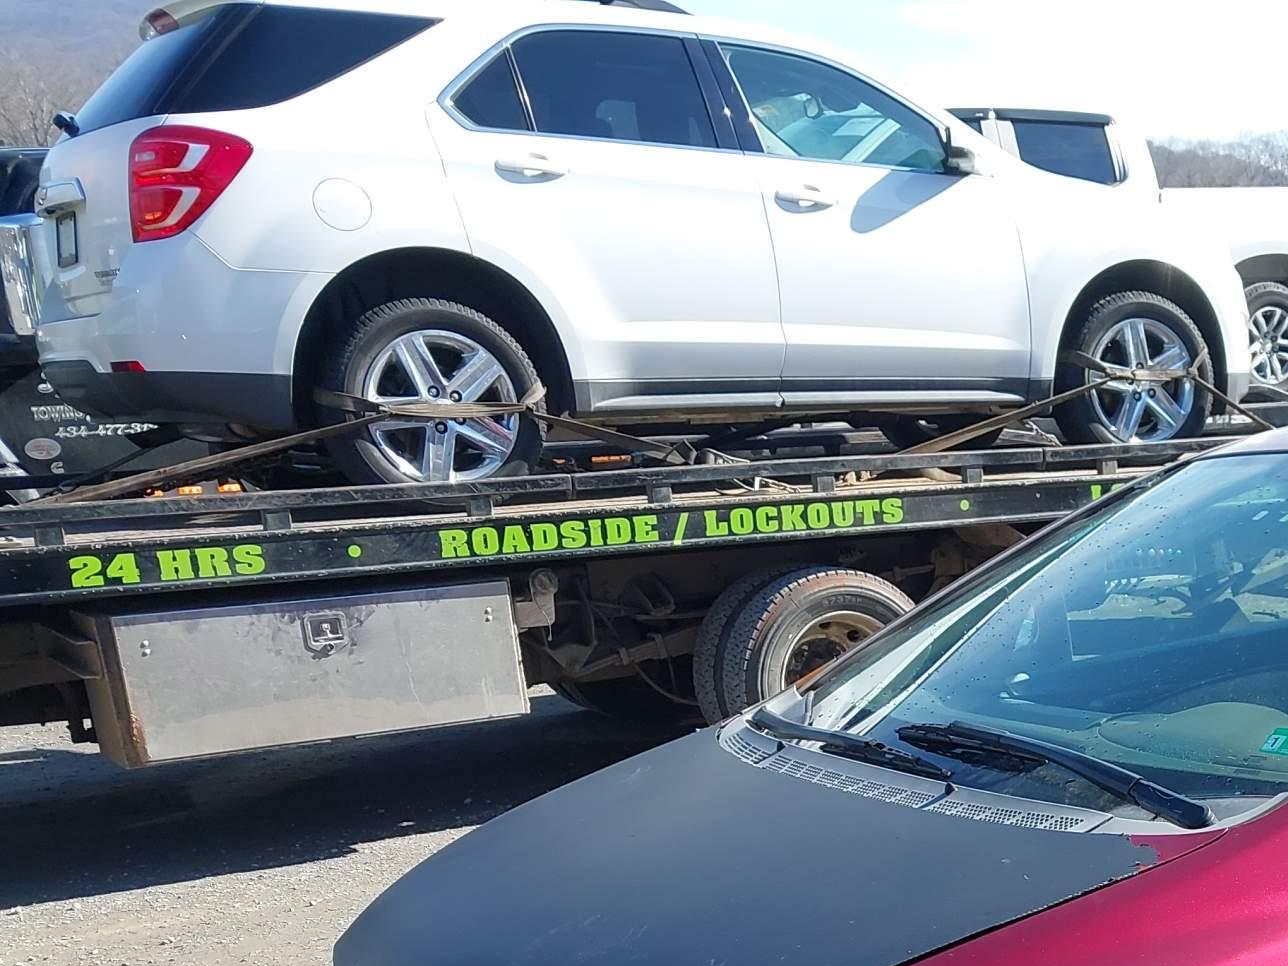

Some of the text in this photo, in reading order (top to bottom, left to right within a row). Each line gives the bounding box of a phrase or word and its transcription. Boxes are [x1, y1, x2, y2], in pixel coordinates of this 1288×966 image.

[69, 553, 141, 588] 24
[156, 544, 265, 581] HRS
[438, 514, 660, 558] ROADSIDE
[703, 497, 905, 537] LOCKOUTS
